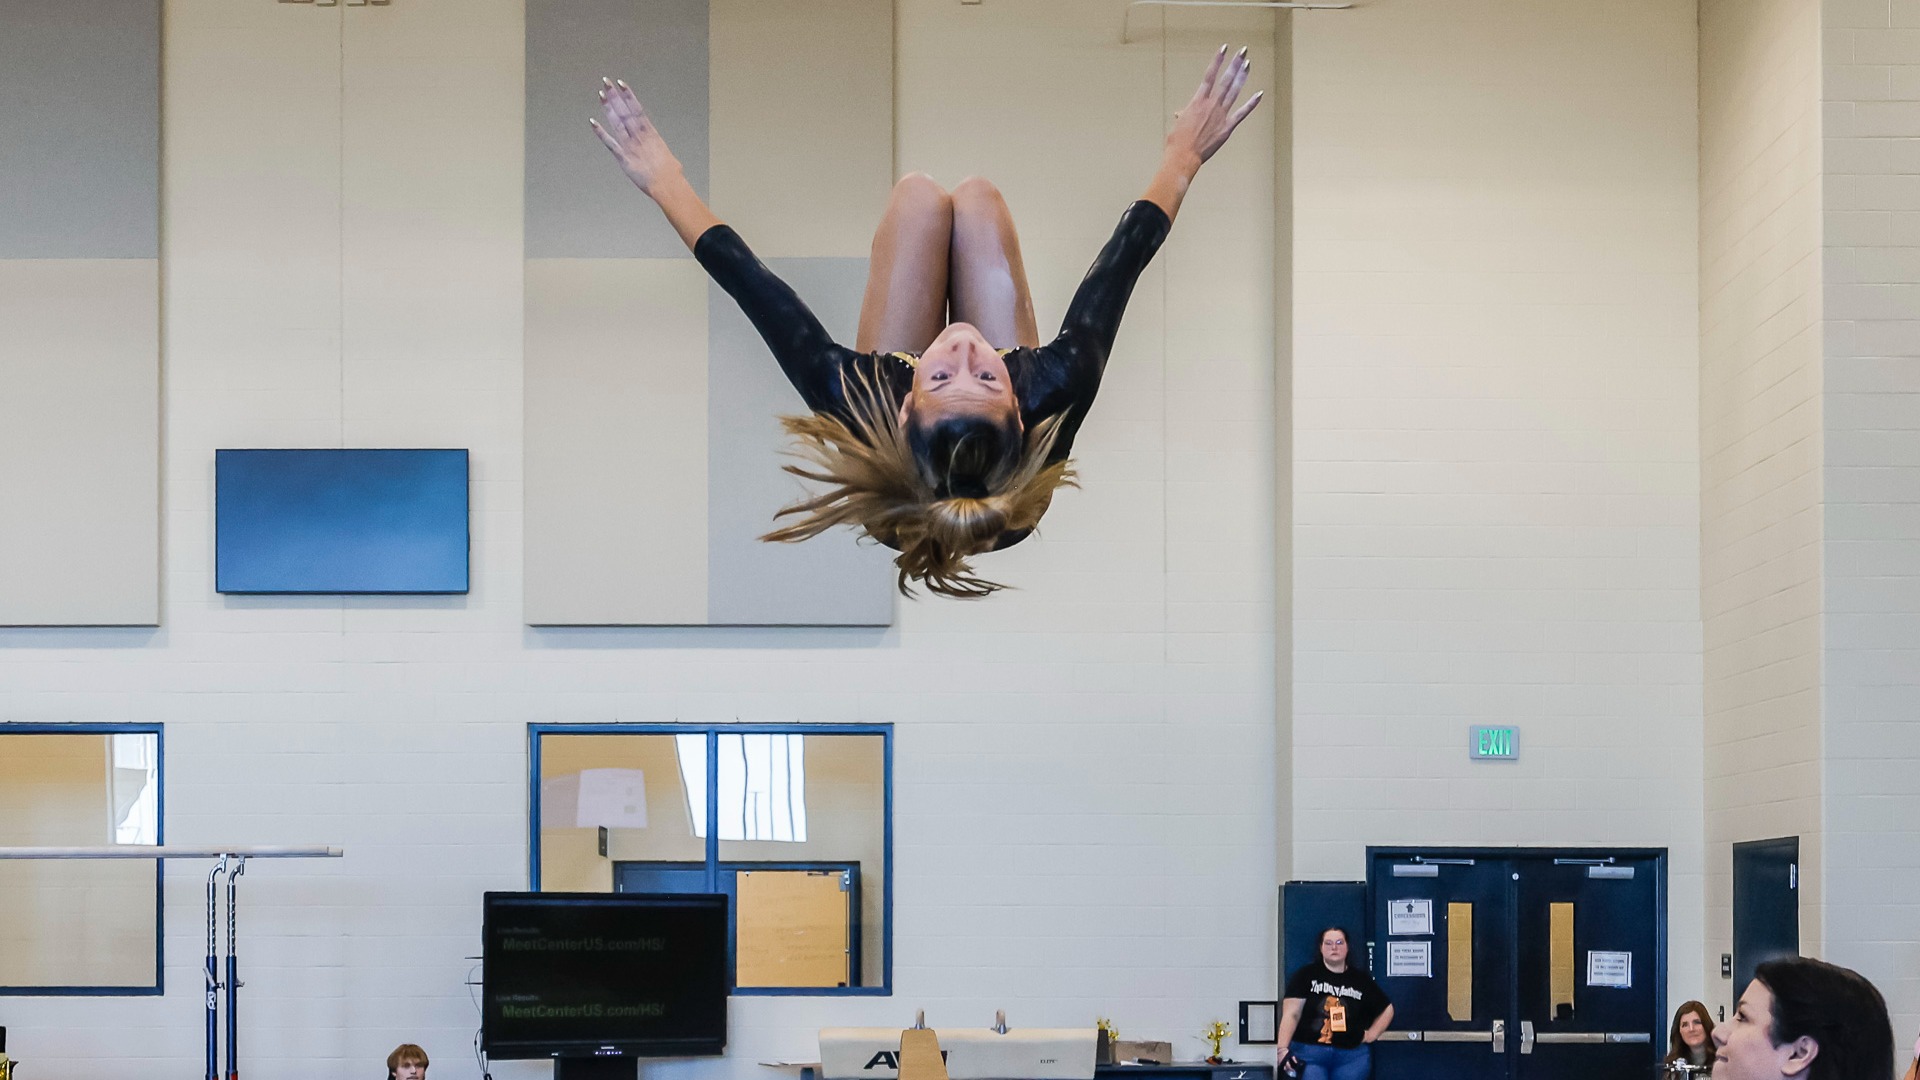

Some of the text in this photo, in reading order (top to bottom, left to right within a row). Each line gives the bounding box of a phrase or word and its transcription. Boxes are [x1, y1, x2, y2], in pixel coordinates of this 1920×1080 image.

[1479, 729, 1513, 755] EXIT
[1310, 980, 1322, 994] The
[502, 1003, 664, 1017] MeetCenterUS.com/HS/
